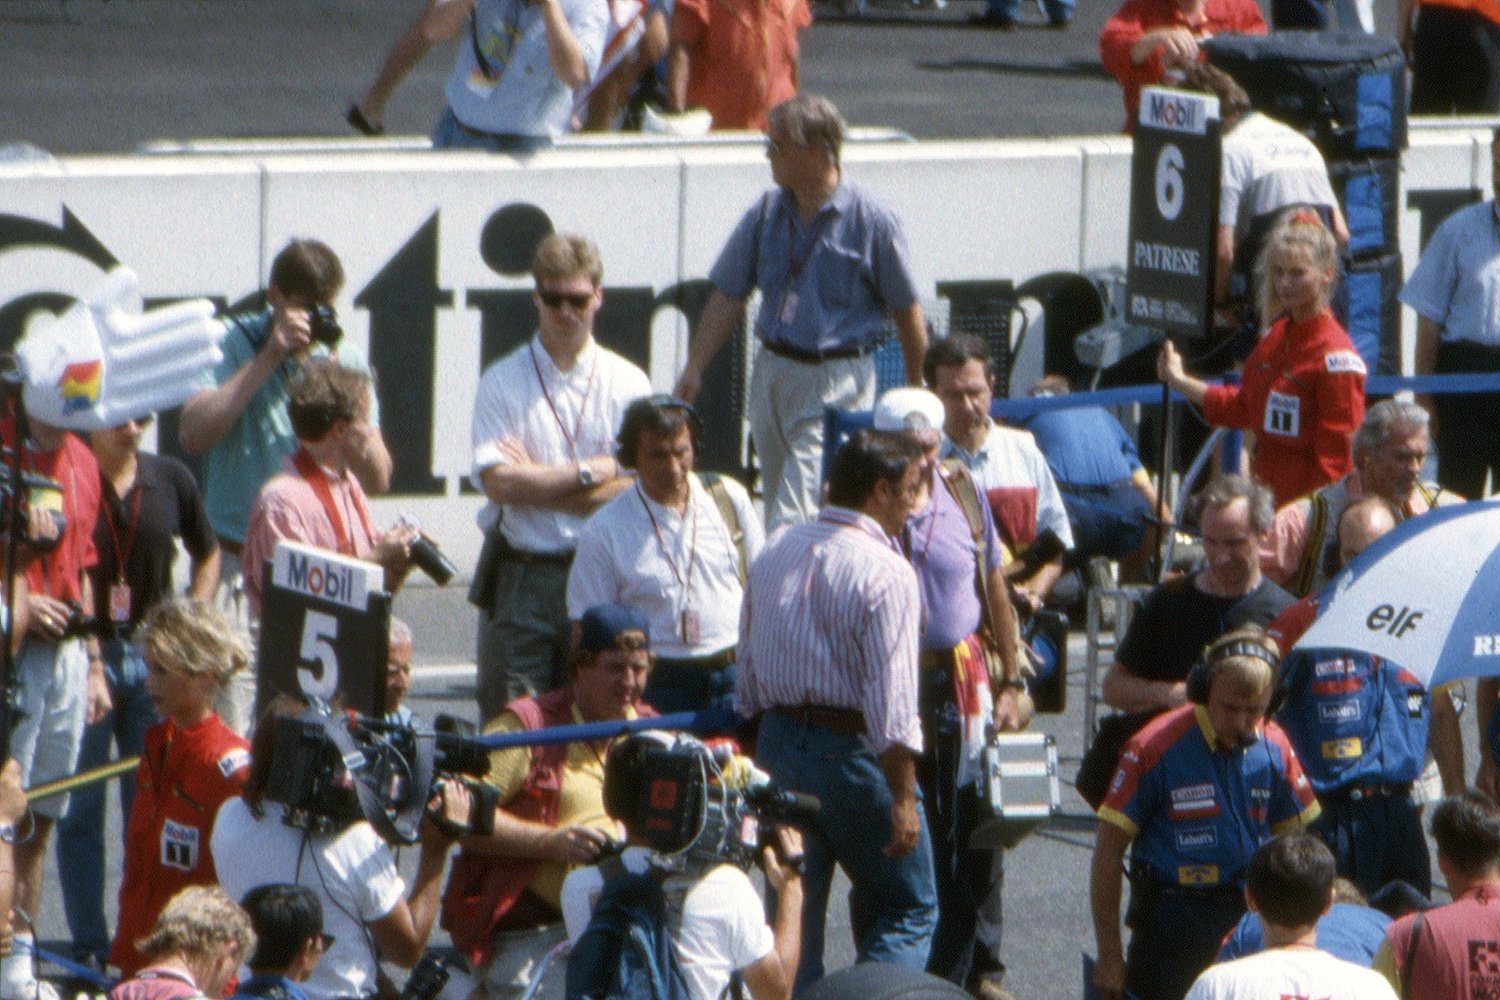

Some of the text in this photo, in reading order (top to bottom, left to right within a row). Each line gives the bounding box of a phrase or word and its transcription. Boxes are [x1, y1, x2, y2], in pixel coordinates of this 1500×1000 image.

[1151, 94, 1197, 126] Mobil
[1155, 143, 1186, 222] 6
[1134, 240, 1201, 277] PATRESE
[287, 552, 353, 602] Mobil
[1366, 603, 1424, 638] elf
[297, 609, 339, 700] 5
